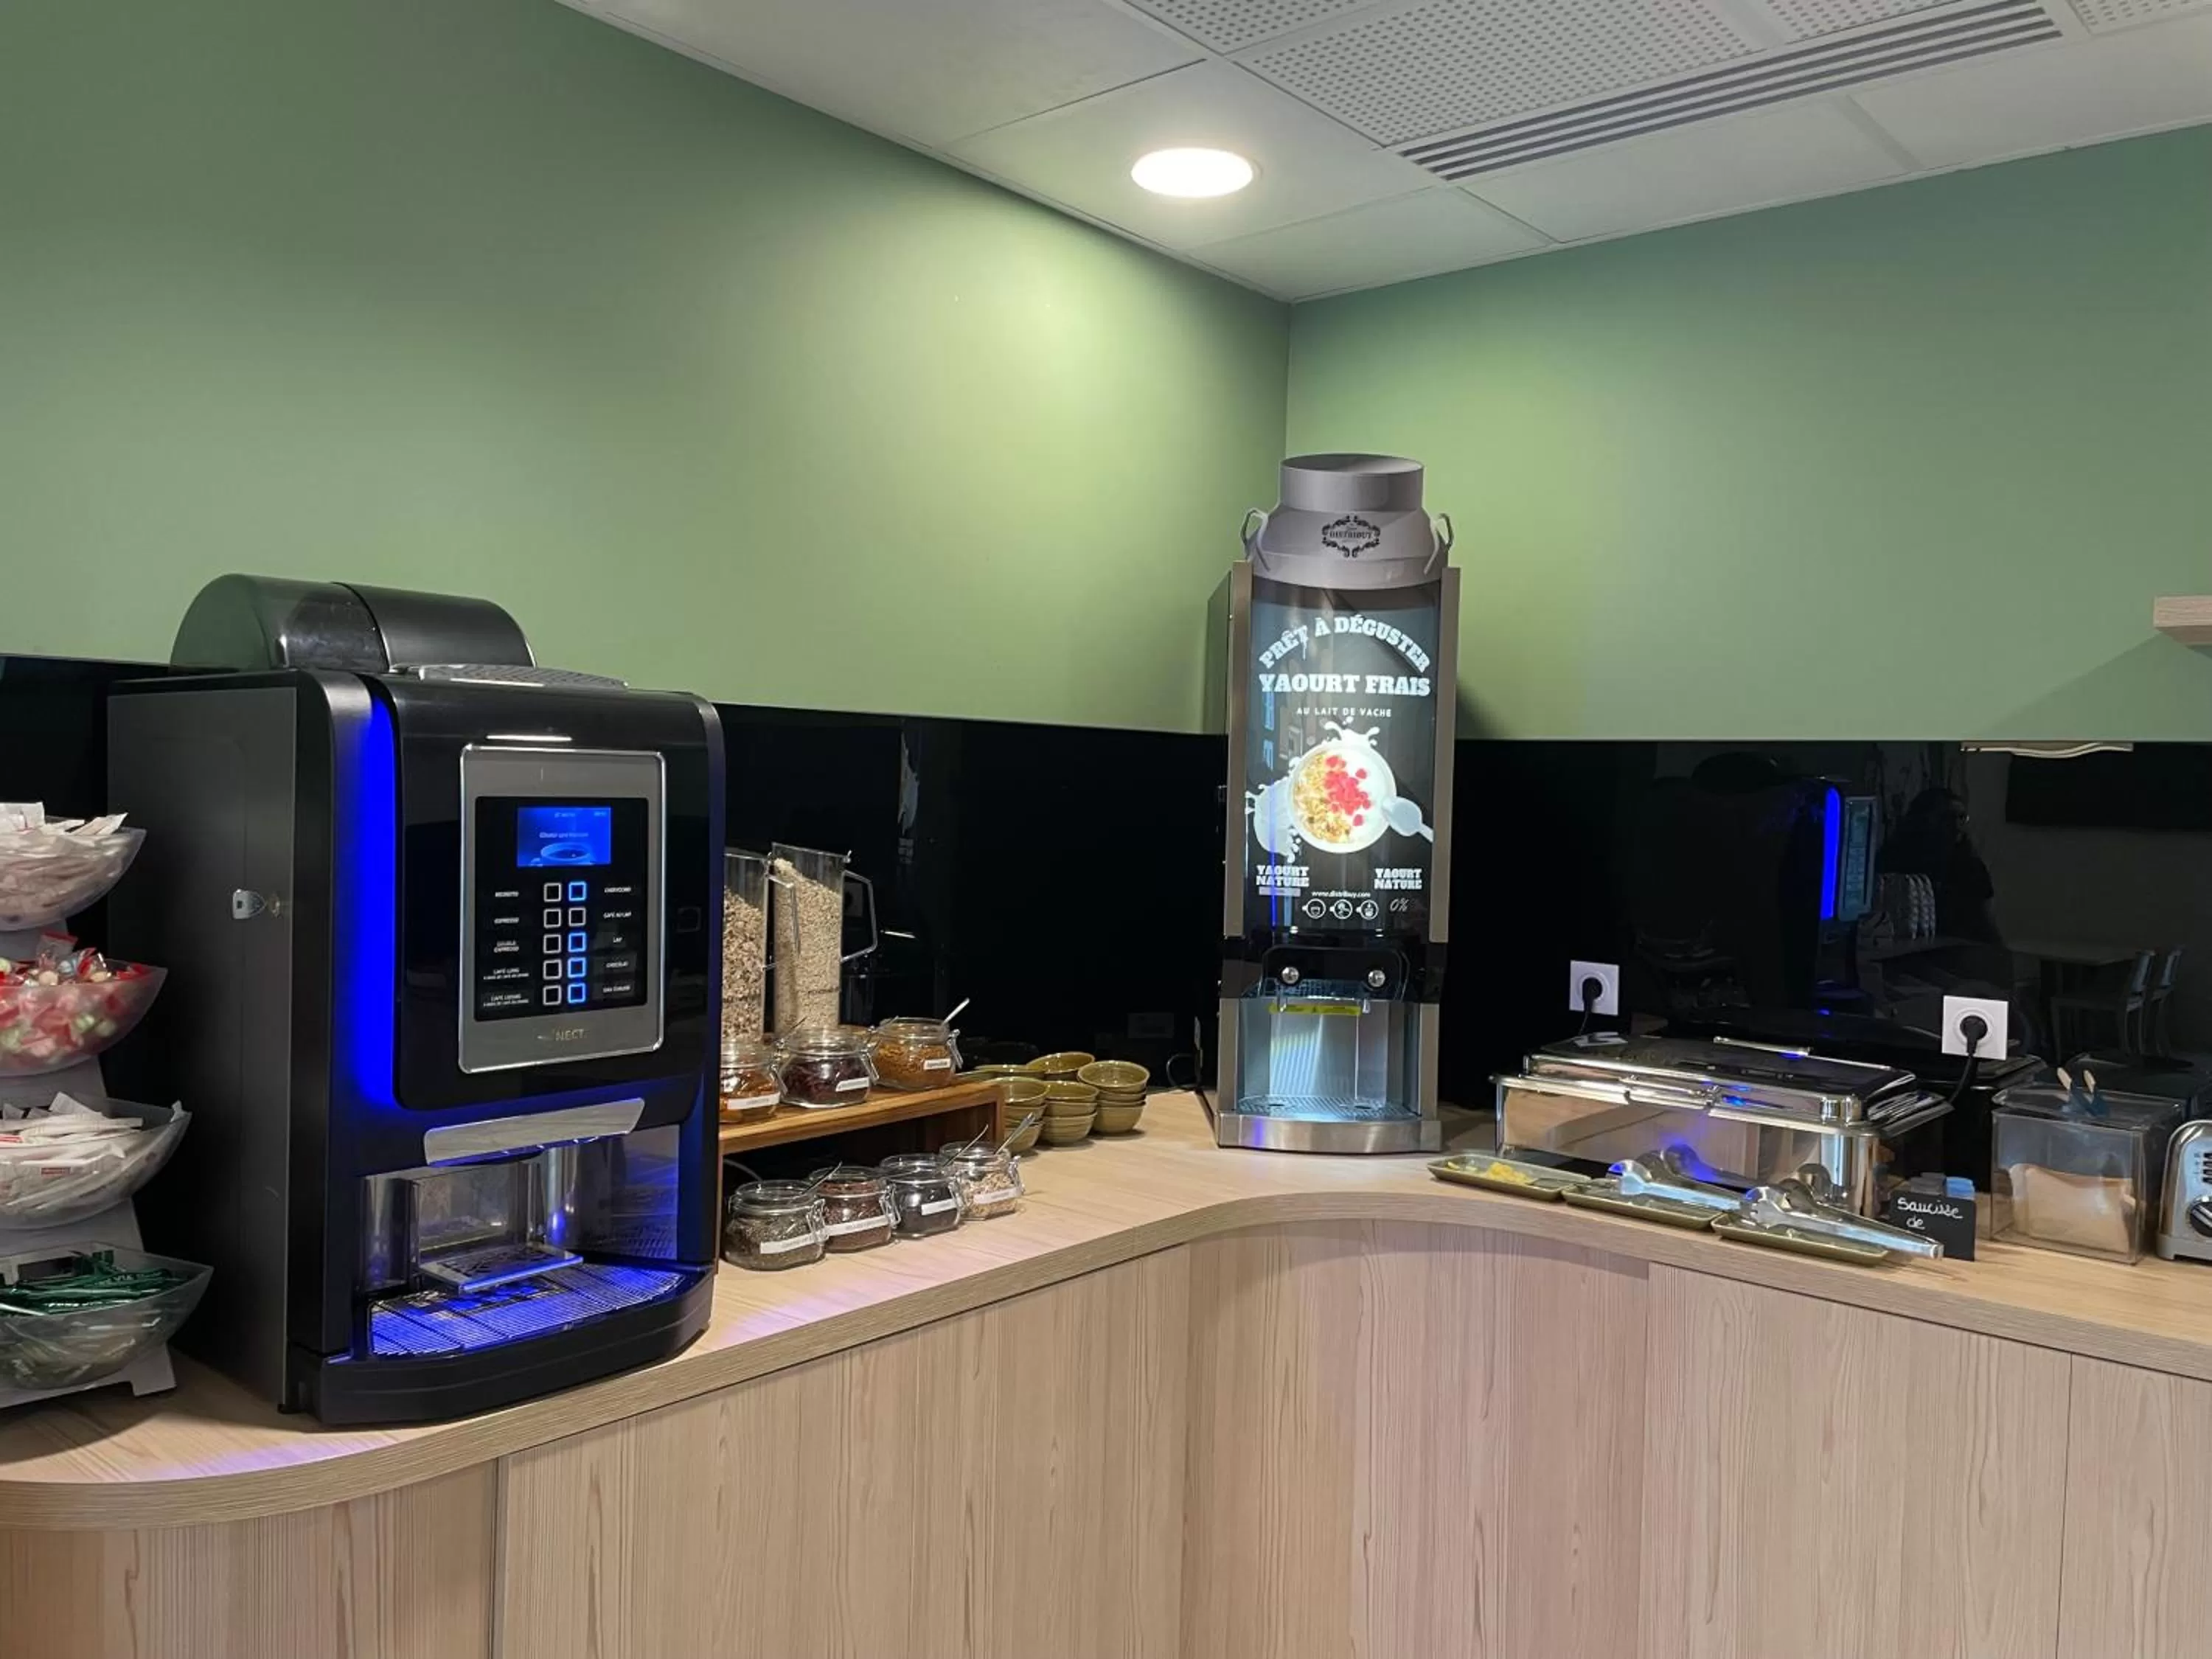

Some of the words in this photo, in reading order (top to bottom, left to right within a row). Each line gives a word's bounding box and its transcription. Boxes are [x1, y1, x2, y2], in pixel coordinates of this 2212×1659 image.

[1259, 625, 1308, 669] PRÊT
[1314, 617, 1331, 638] À
[1334, 613, 1430, 672] DÉGUSTER
[1259, 673, 1360, 692] YAOURT
[1365, 675, 1431, 696] FRAIS
[1296, 707, 1310, 715] AU
[1315, 707, 1339, 716] LAIT
[1343, 707, 1356, 716] DE
[1359, 707, 1391, 717] VACHE
[1256, 865, 1310, 876] YAOURT
[1374, 868, 1422, 878] YAOURT
[1256, 875, 1310, 887] NATURE
[1374, 878, 1422, 890] NATURE
